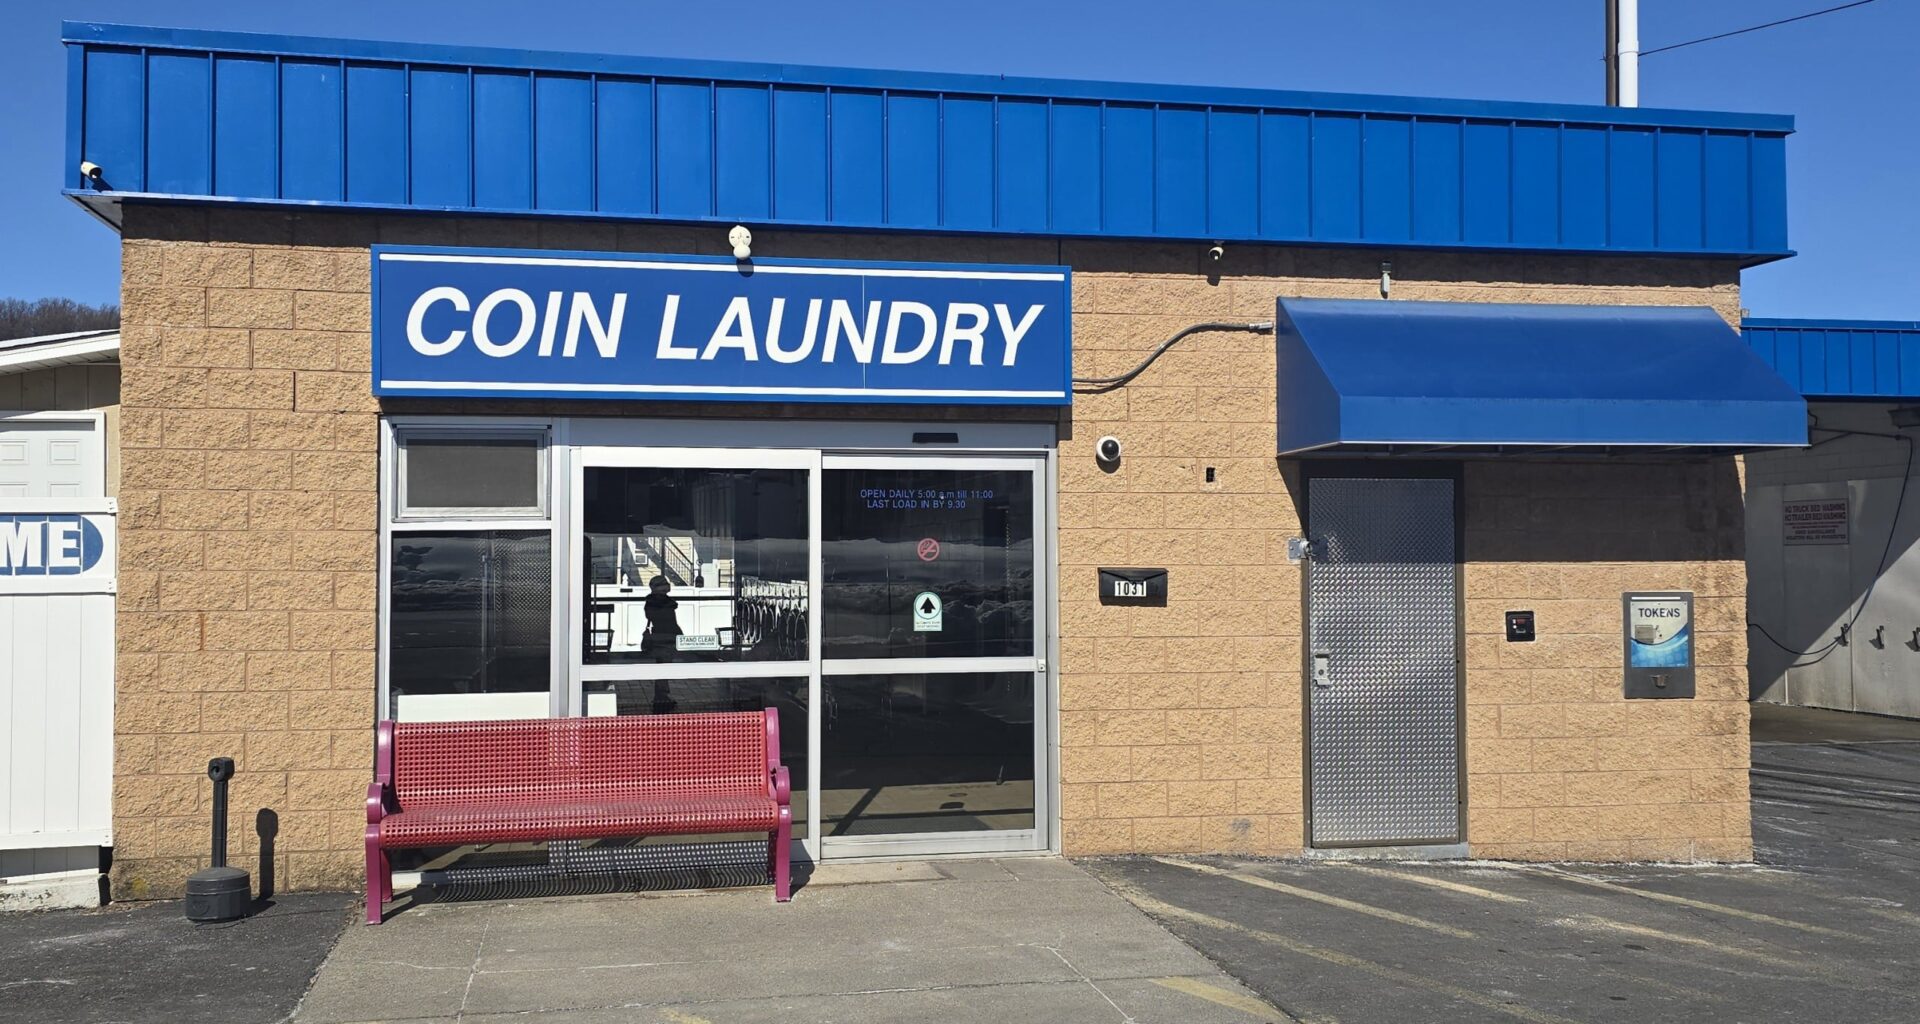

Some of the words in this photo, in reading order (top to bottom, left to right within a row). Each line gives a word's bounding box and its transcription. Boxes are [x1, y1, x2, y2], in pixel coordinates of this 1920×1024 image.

[406, 286, 627, 358] COIN
[656, 294, 1046, 366] LAUNDRY
[860, 489, 886, 498] OPEN
[889, 489, 915, 498] DAILY
[918, 490, 936, 498] 5:00
[957, 490, 968, 499] till
[971, 490, 993, 499] 11:00
[867, 500, 889, 508] LAST
[893, 500, 917, 508] LOAD
[920, 500, 930, 508] IN
[933, 500, 945, 508] BY
[0, 521, 81, 567] ME
[1117, 581, 1144, 595] 1031
[1638, 608, 1680, 618] TOKENS
